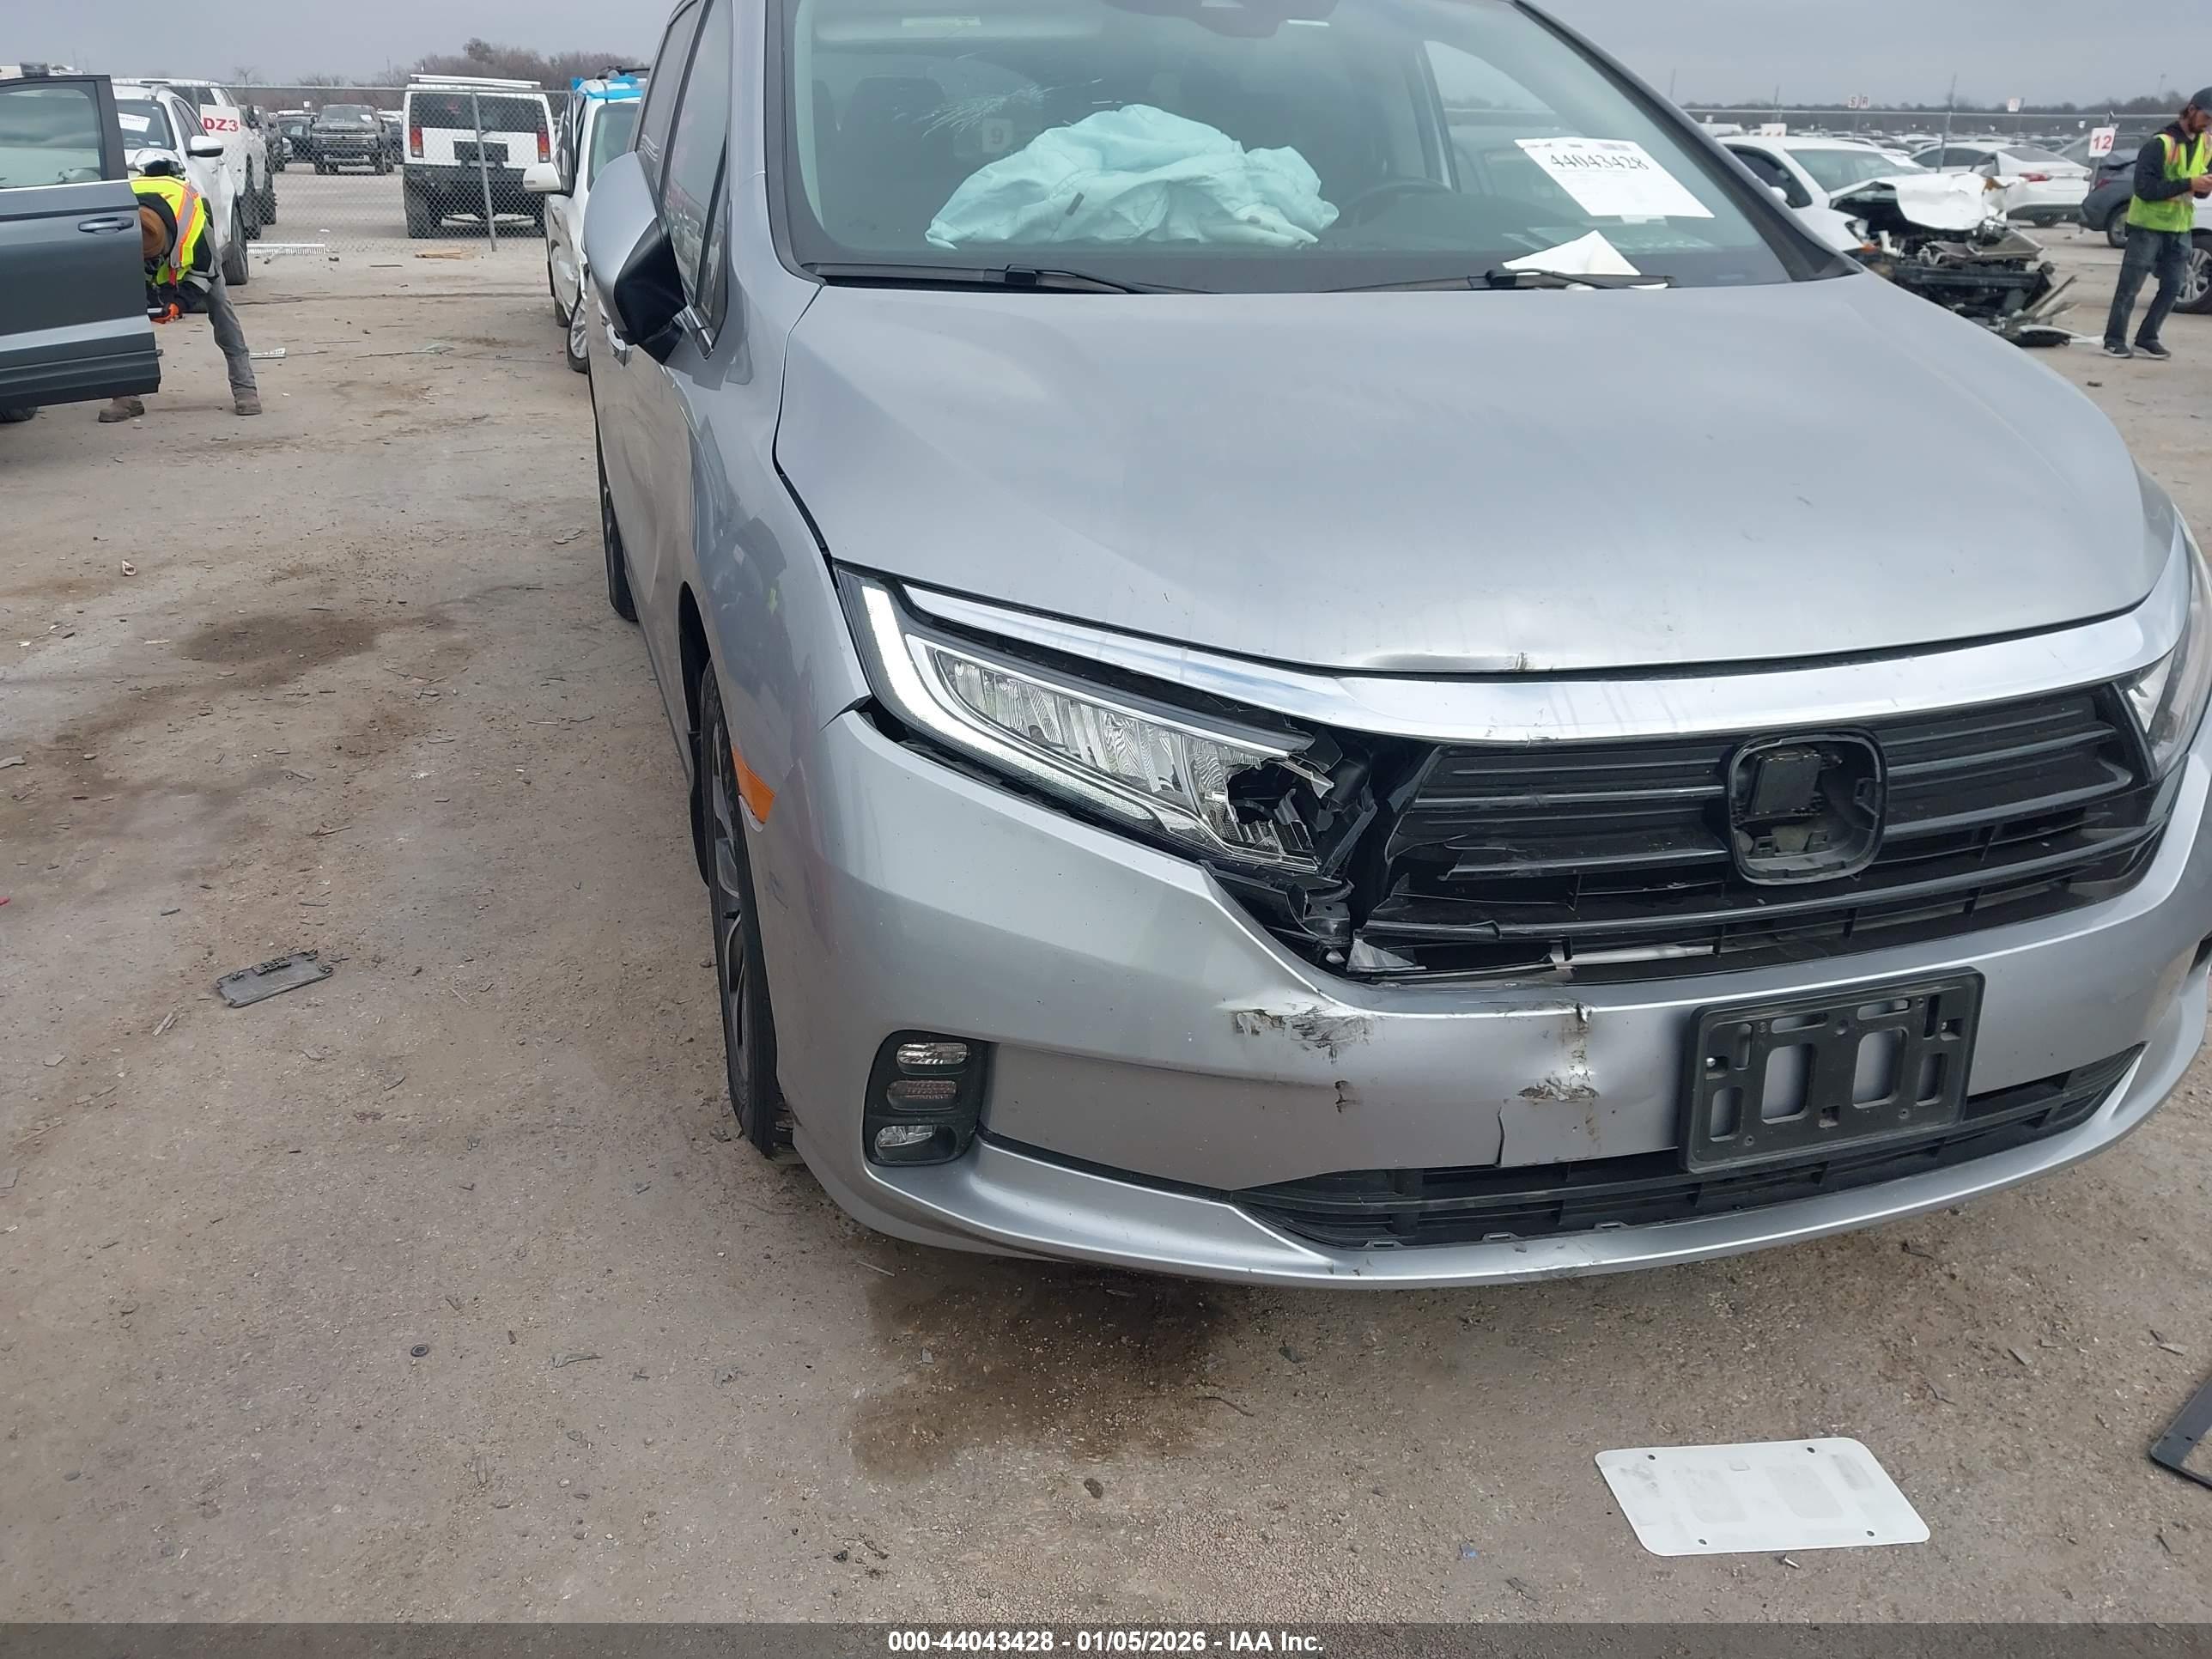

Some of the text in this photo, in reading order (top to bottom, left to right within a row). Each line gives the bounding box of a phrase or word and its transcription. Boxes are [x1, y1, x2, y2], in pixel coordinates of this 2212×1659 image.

[203, 117, 239, 132] DZ3
[2093, 135, 2112, 150] 12
[1549, 154, 1650, 171] 44043428
